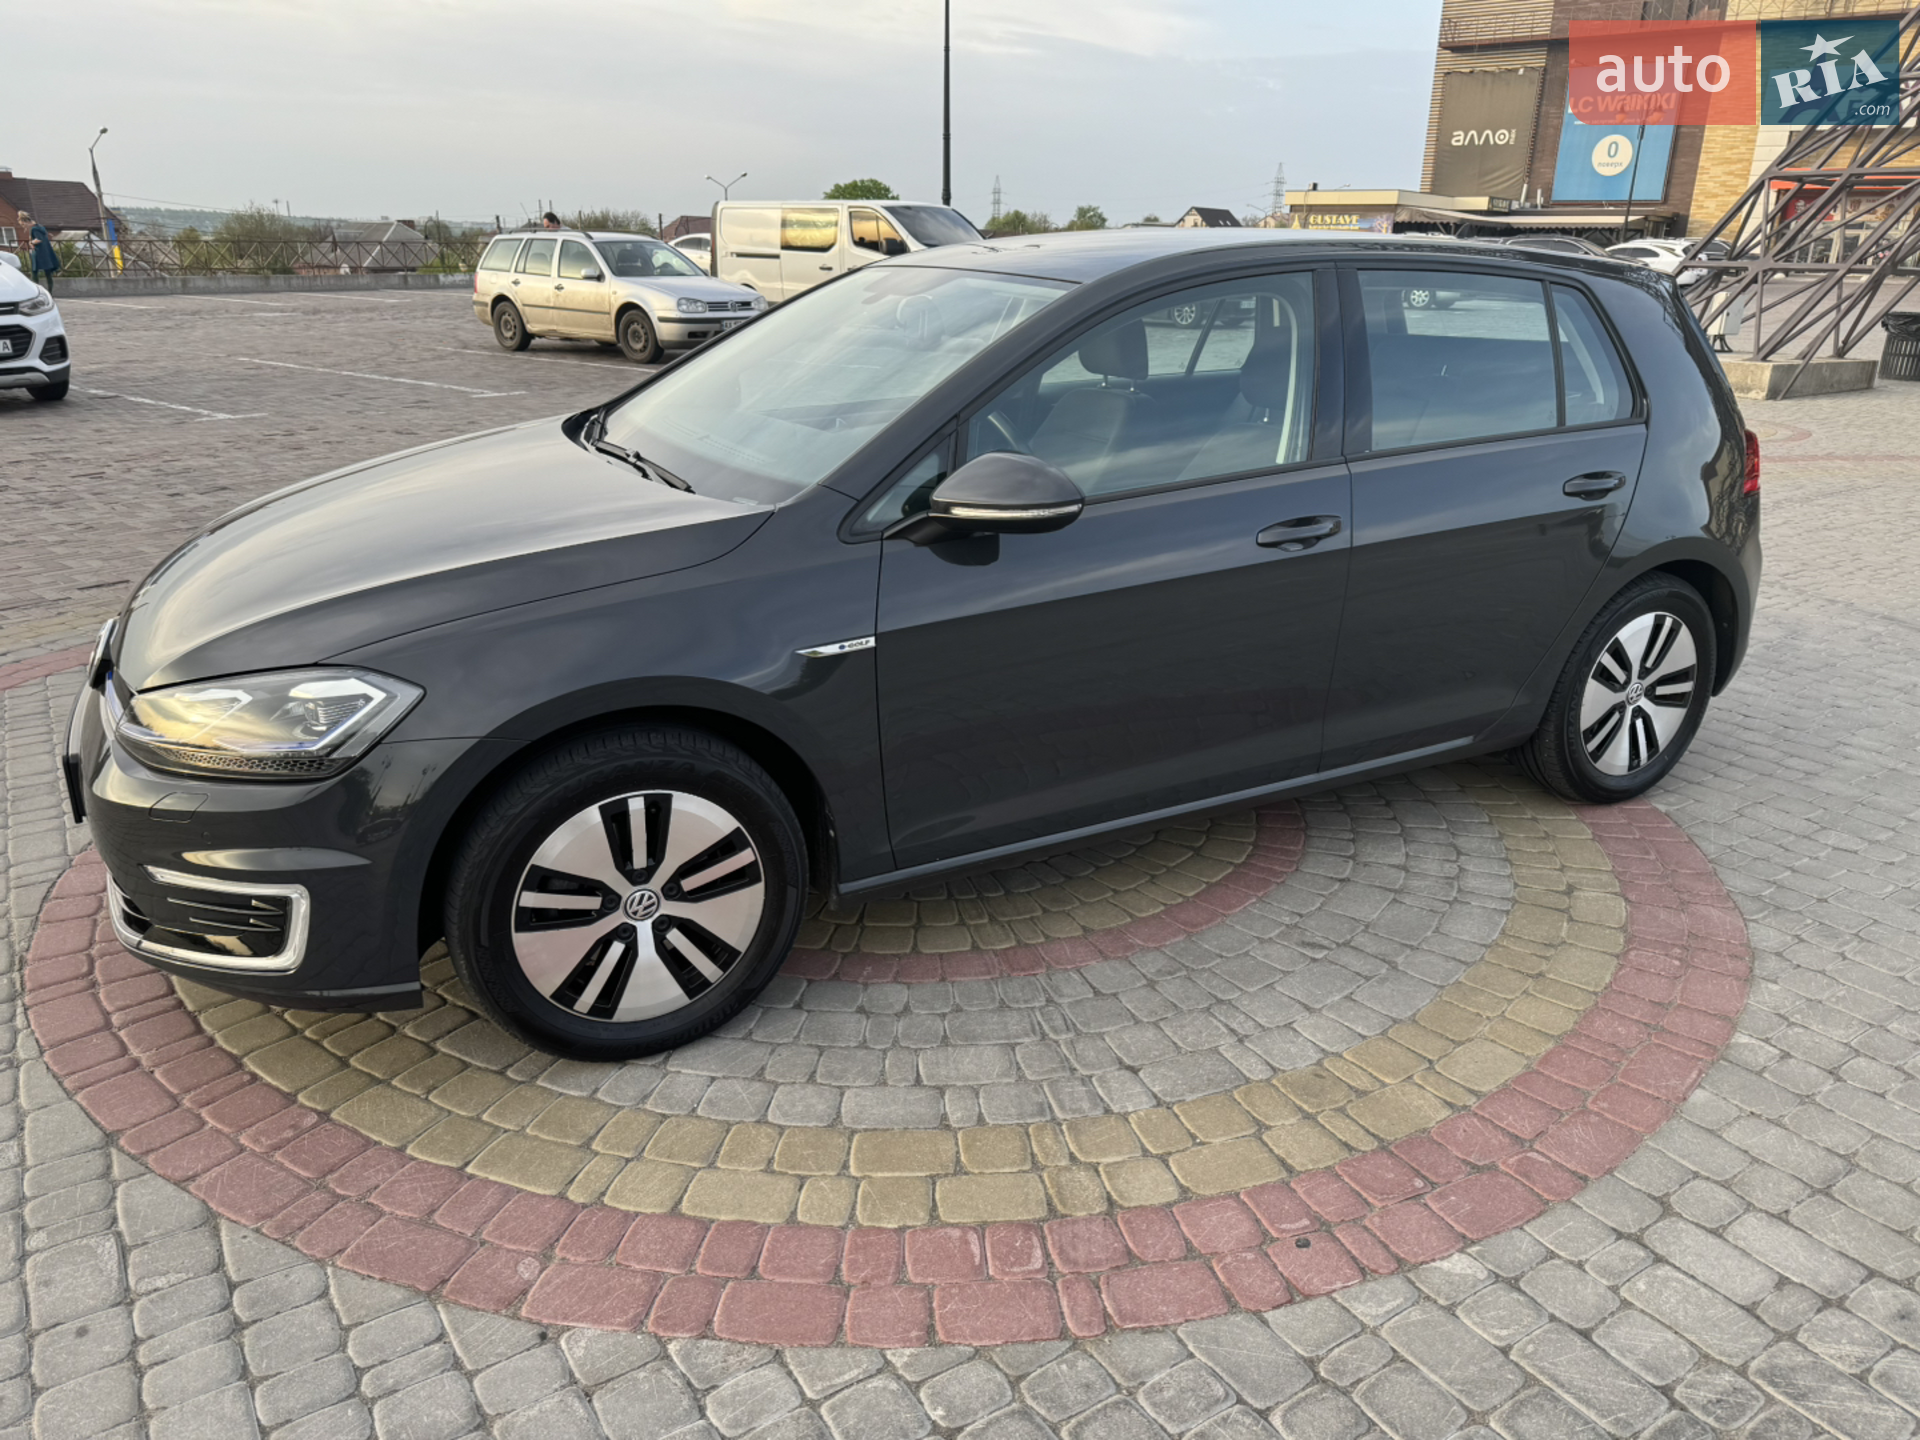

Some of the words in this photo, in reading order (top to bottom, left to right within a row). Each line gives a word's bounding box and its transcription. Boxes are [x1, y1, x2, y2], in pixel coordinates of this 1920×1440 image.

[1607, 141, 1619, 159] 0
[1597, 161, 1624, 169] поверх
[1309, 214, 1360, 225] GUSTAVE
